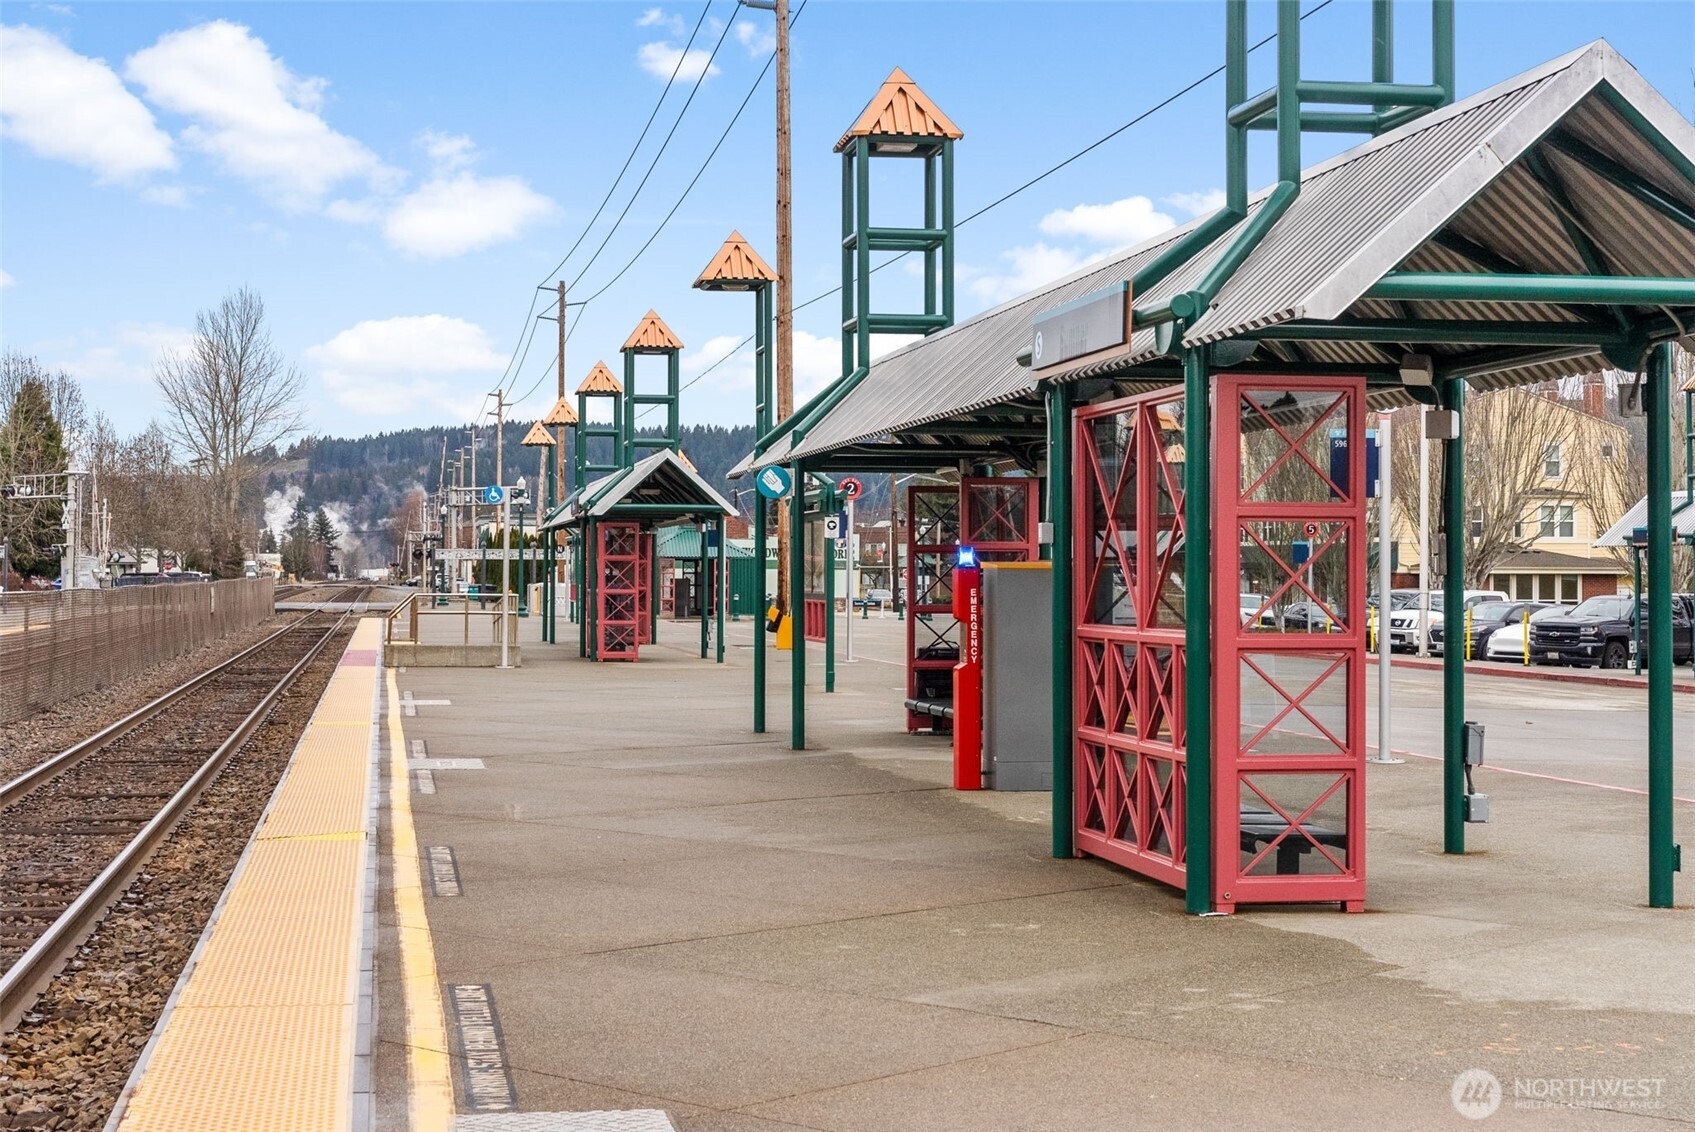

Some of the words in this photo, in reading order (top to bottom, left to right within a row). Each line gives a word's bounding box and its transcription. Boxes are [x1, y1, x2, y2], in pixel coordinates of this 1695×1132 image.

[847, 483, 855, 495] 2
[1308, 525, 1315, 534] 5
[970, 588, 978, 664] EMERGENCY
[461, 1026, 499, 1049] BEHIND
